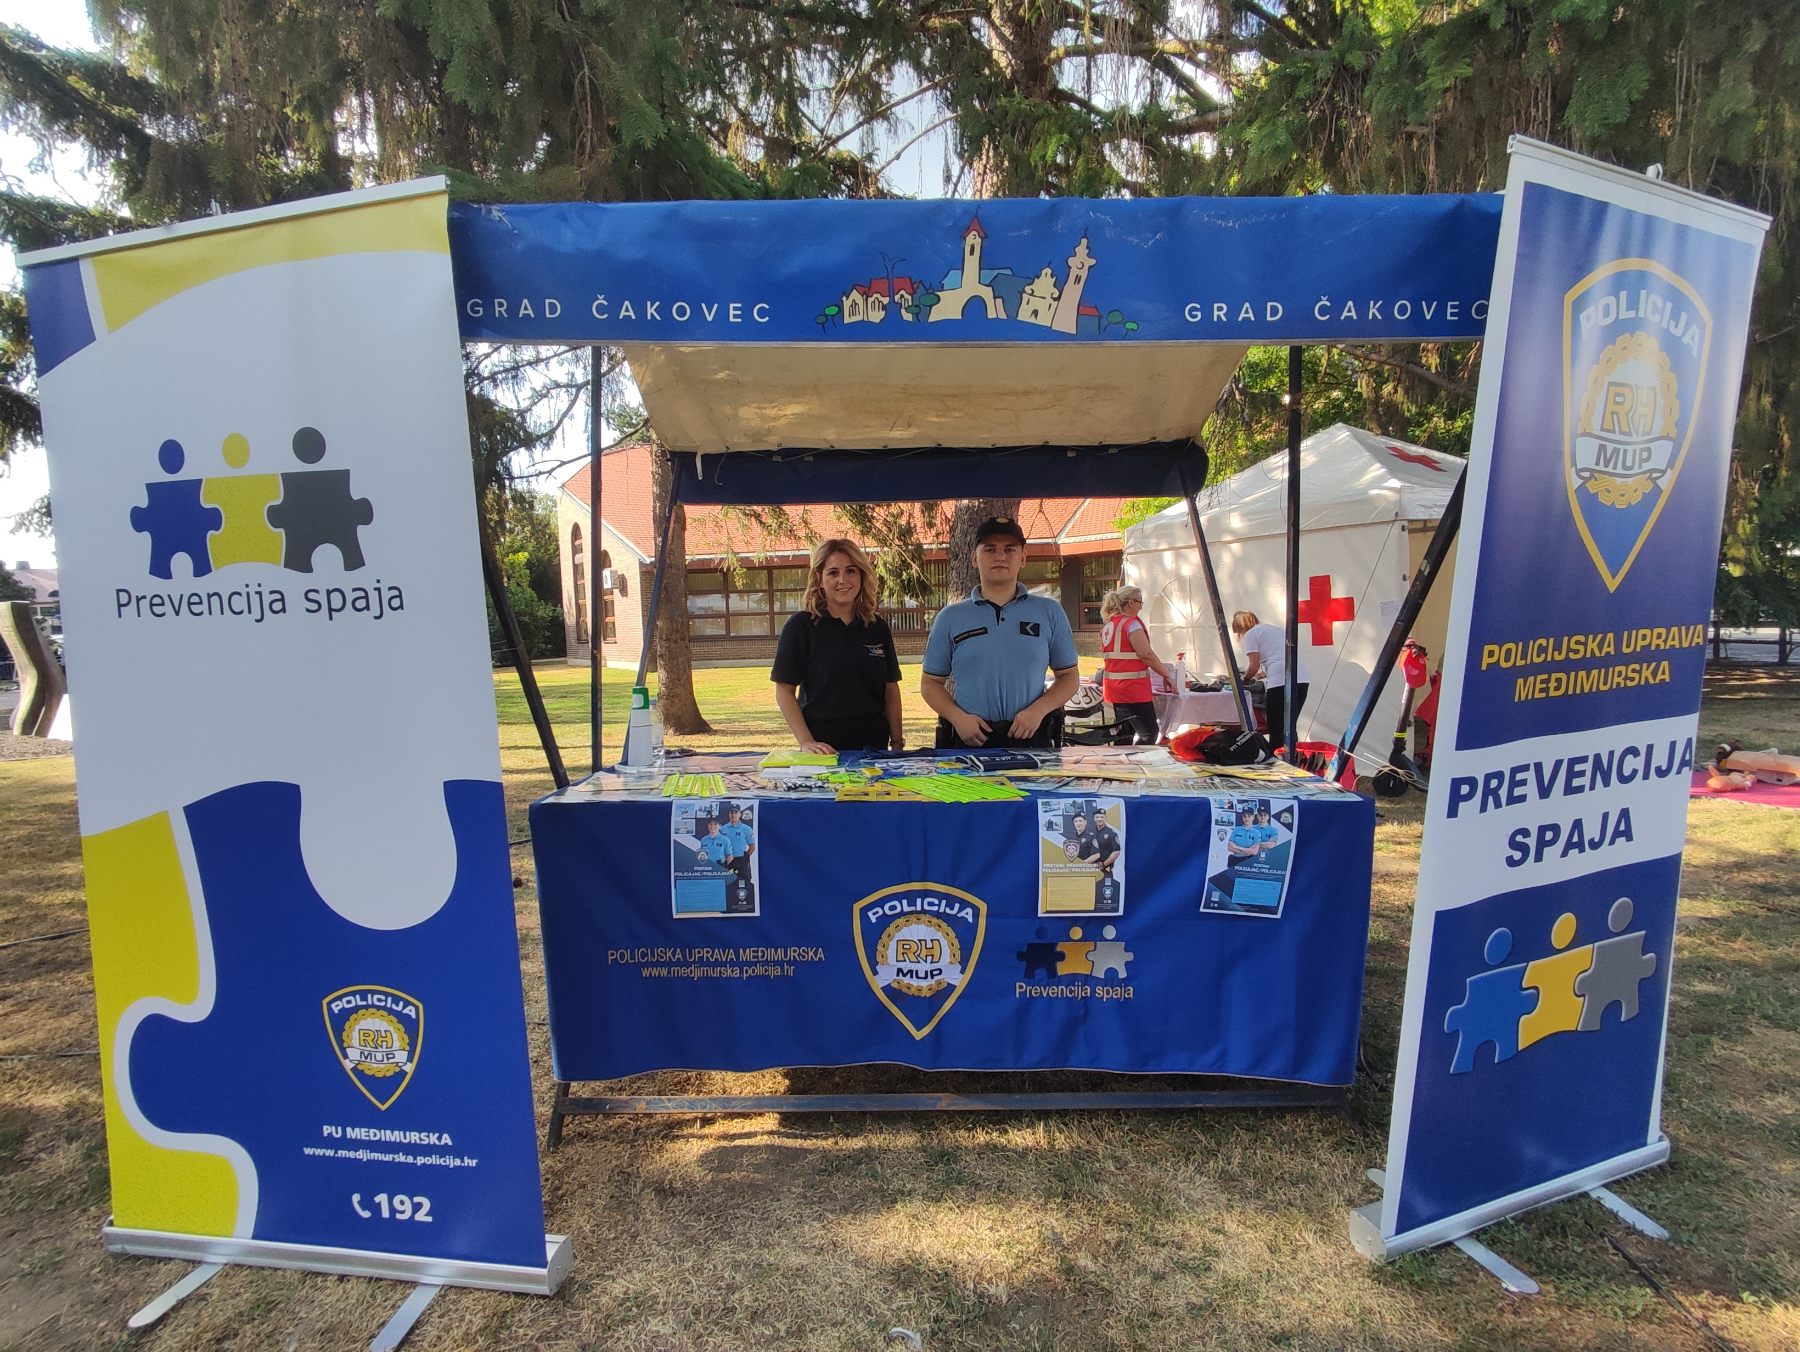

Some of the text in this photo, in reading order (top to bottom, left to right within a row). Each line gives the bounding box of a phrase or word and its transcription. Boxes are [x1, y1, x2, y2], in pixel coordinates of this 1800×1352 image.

[466, 294, 770, 323] GRAD ČAKOVEC
[1184, 295, 1489, 322] GRAD ČAKOVEC
[1579, 289, 1700, 357] POLICIJA
[1600, 381, 1657, 438] RH
[1594, 443, 1653, 472] MUP
[115, 579, 405, 623] Prevencija spaja
[1481, 624, 1704, 670] POLICIJSKA UPRAVA
[1514, 660, 1671, 703] MEĐIMURSKA
[1446, 736, 1693, 819] PREVENCIJA
[1505, 807, 1634, 869] SPAJA
[867, 897, 973, 924] POLICIJA
[607, 946, 825, 964] POLICIJSKA UPRAVA MEĐIMURSKA
[896, 938, 942, 964] RH
[641, 963, 795, 980] www.medjimurska.policija.hr
[896, 967, 943, 980] MUP
[1015, 982, 1134, 1002] Prevencija spaja
[330, 993, 416, 1019] POLICIJA
[358, 1028, 394, 1049] RH
[359, 1051, 396, 1063] MUP
[322, 1125, 453, 1146] PU MEĐIMURSKA
[303, 1147, 478, 1168] www.medjimurska.policija.hr
[373, 1192, 433, 1222] 192
